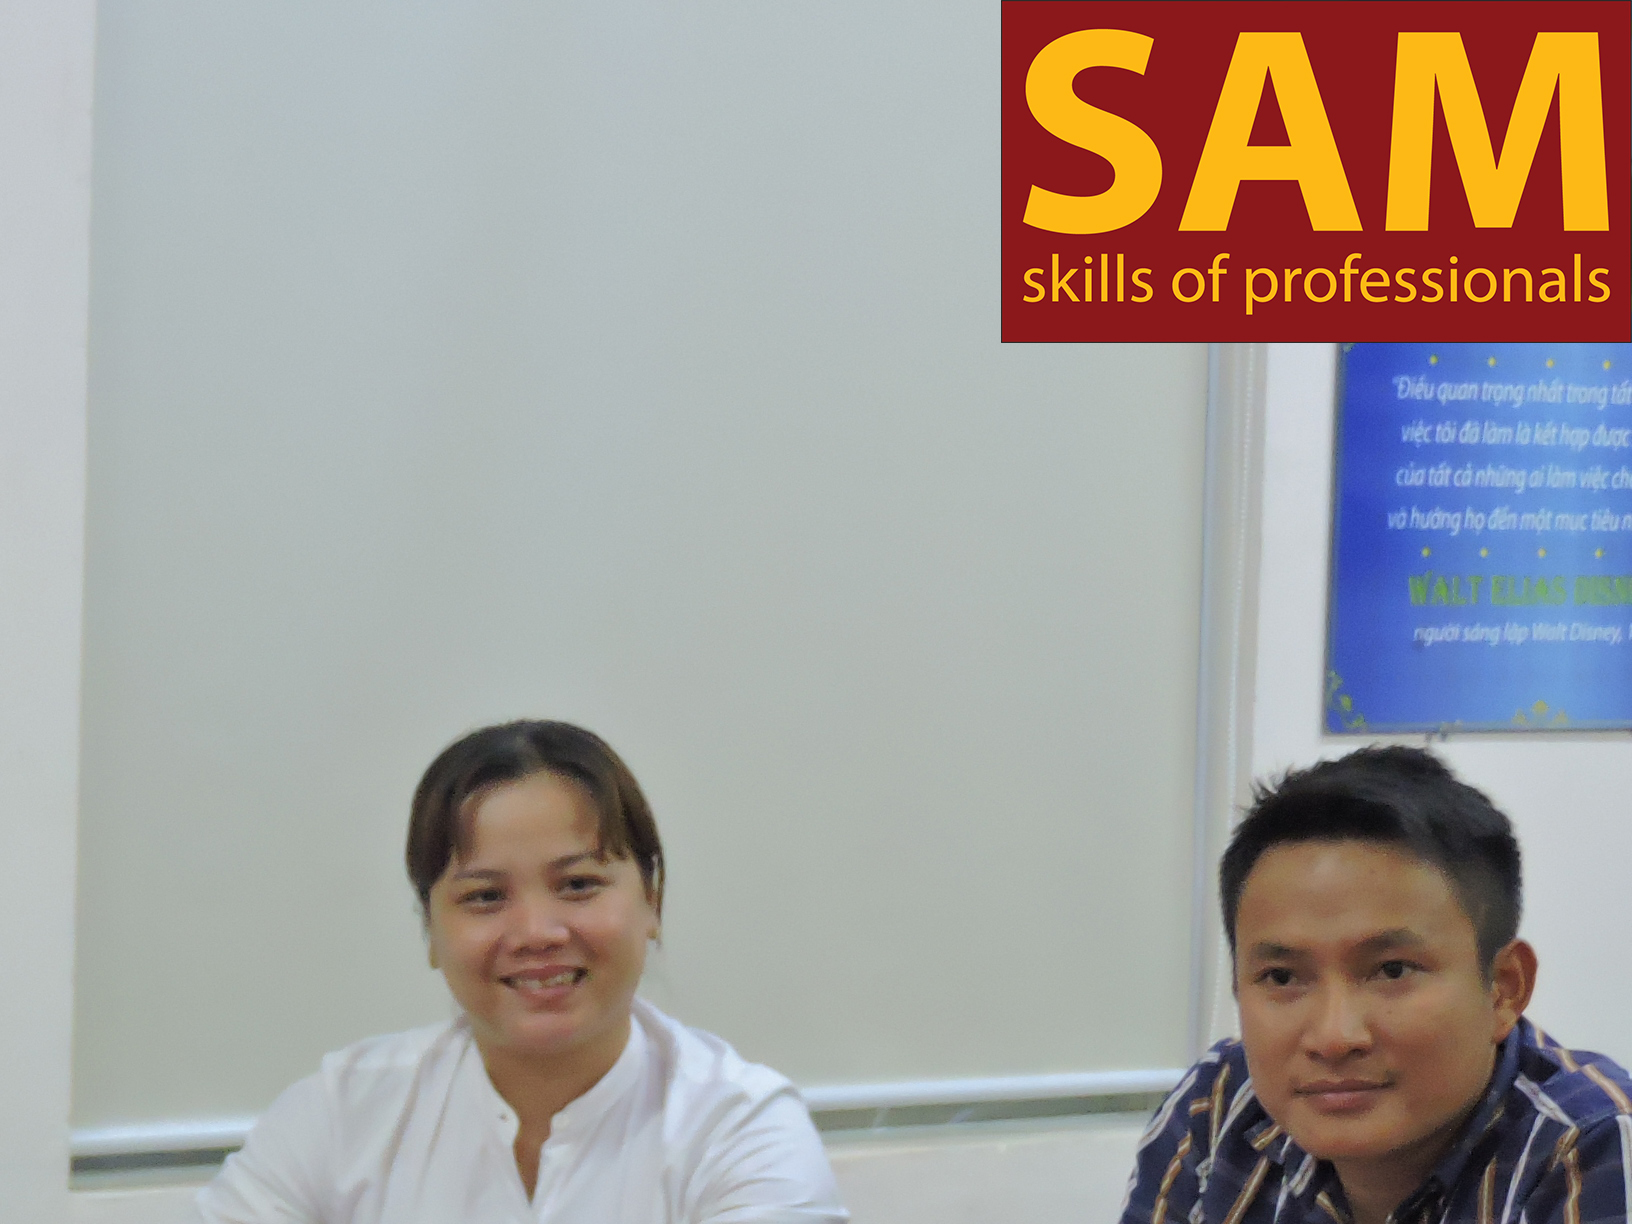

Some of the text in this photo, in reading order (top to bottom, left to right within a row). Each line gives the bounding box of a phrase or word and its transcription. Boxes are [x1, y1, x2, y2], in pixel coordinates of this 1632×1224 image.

[1437, 382, 1477, 406] quan
[1409, 570, 1483, 606] WALT
[1491, 575, 1567, 606] ELIAS
